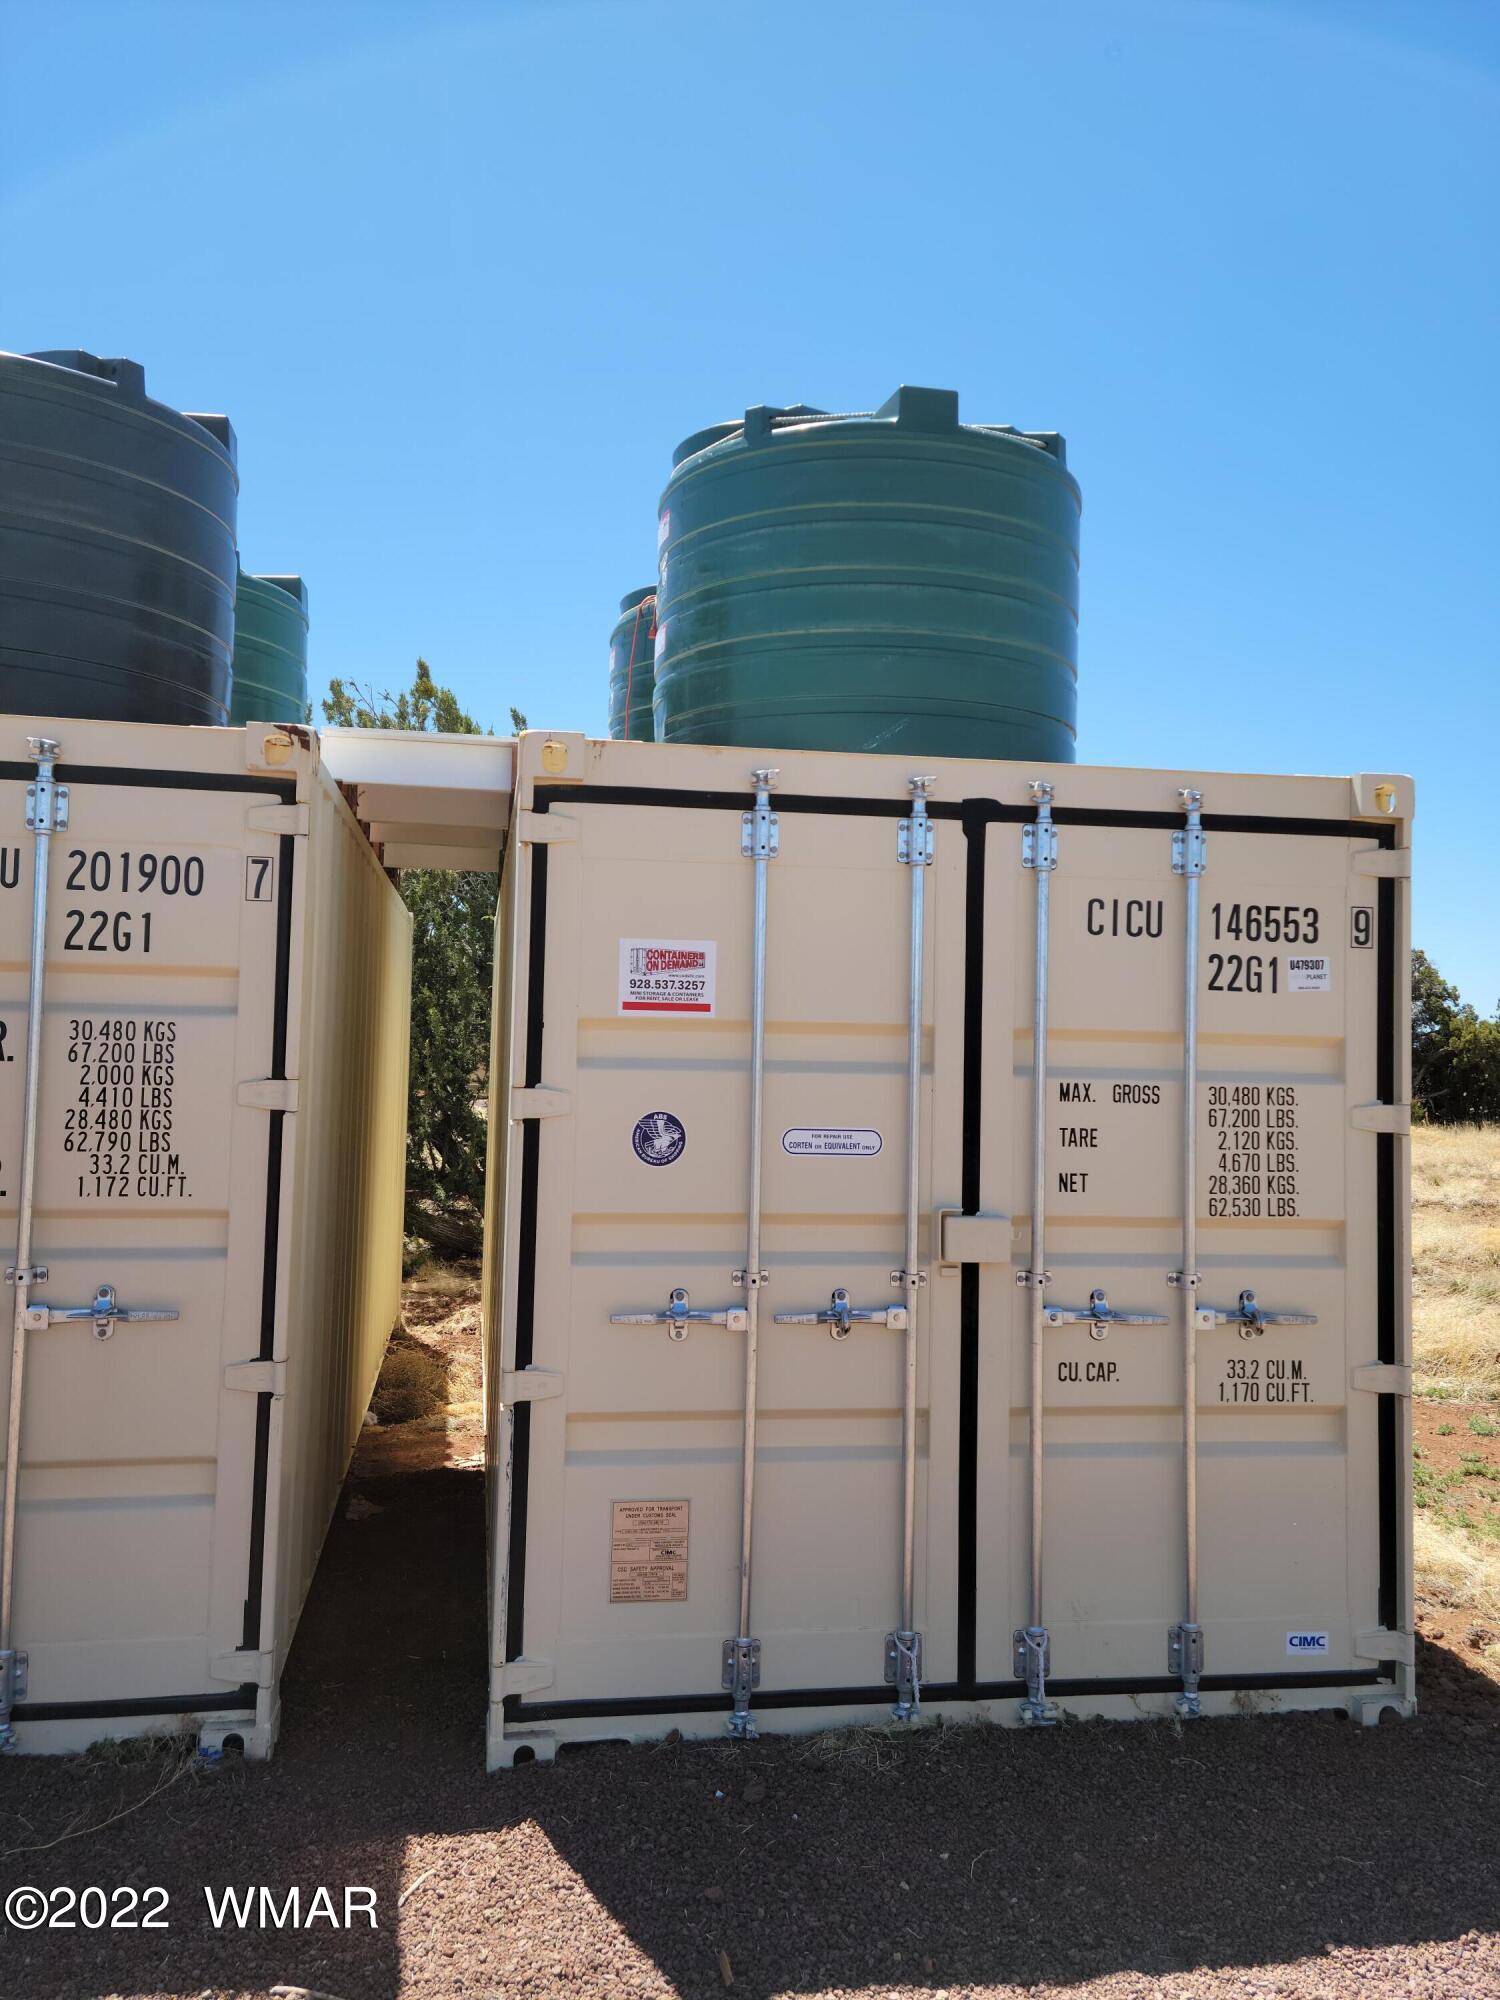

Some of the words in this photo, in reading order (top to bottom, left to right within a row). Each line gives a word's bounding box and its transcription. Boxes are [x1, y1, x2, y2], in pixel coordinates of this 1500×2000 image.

[66, 849, 204, 896] 201900
[251, 859, 269, 899] 7
[64, 909, 151, 952] 22G1
[1087, 898, 1163, 938] CICU
[1211, 902, 1319, 944] 146553
[1354, 909, 1370, 945] 9
[646, 949, 705, 960] CONTAINERS
[1290, 959, 1324, 970] U479307
[646, 960, 659, 972] ON
[660, 960, 699, 971] DEMAND
[1207, 953, 1278, 994] 22G1
[629, 979, 706, 991] 928.537.3257
[143, 1021, 176, 1042] KGS
[142, 1043, 174, 1064] LBS
[141, 1065, 174, 1087] KGS
[140, 1087, 172, 1108] LBS
[1059, 1083, 1096, 1103] MAX.
[1112, 1084, 1161, 1105] GROSS
[1266, 1087, 1299, 1106] KGS.
[139, 1110, 172, 1131] KGS
[1266, 1109, 1299, 1128] LBS.
[138, 1132, 171, 1152] LBS
[788, 1141, 813, 1149] CORTEN
[824, 1142, 861, 1150] EQUIVALENT
[1059, 1128, 1098, 1148] TARE
[1266, 1131, 1299, 1151] KGS.
[89, 1154, 130, 1175] 33.2
[1267, 1153, 1299, 1173] LBS.
[1058, 1173, 1089, 1193] NET
[1267, 1175, 1300, 1195] KGS.
[1267, 1198, 1300, 1217] LBS.
[1226, 1359, 1260, 1380] 33.2
[1289, 1636, 1326, 1647] CIMC
